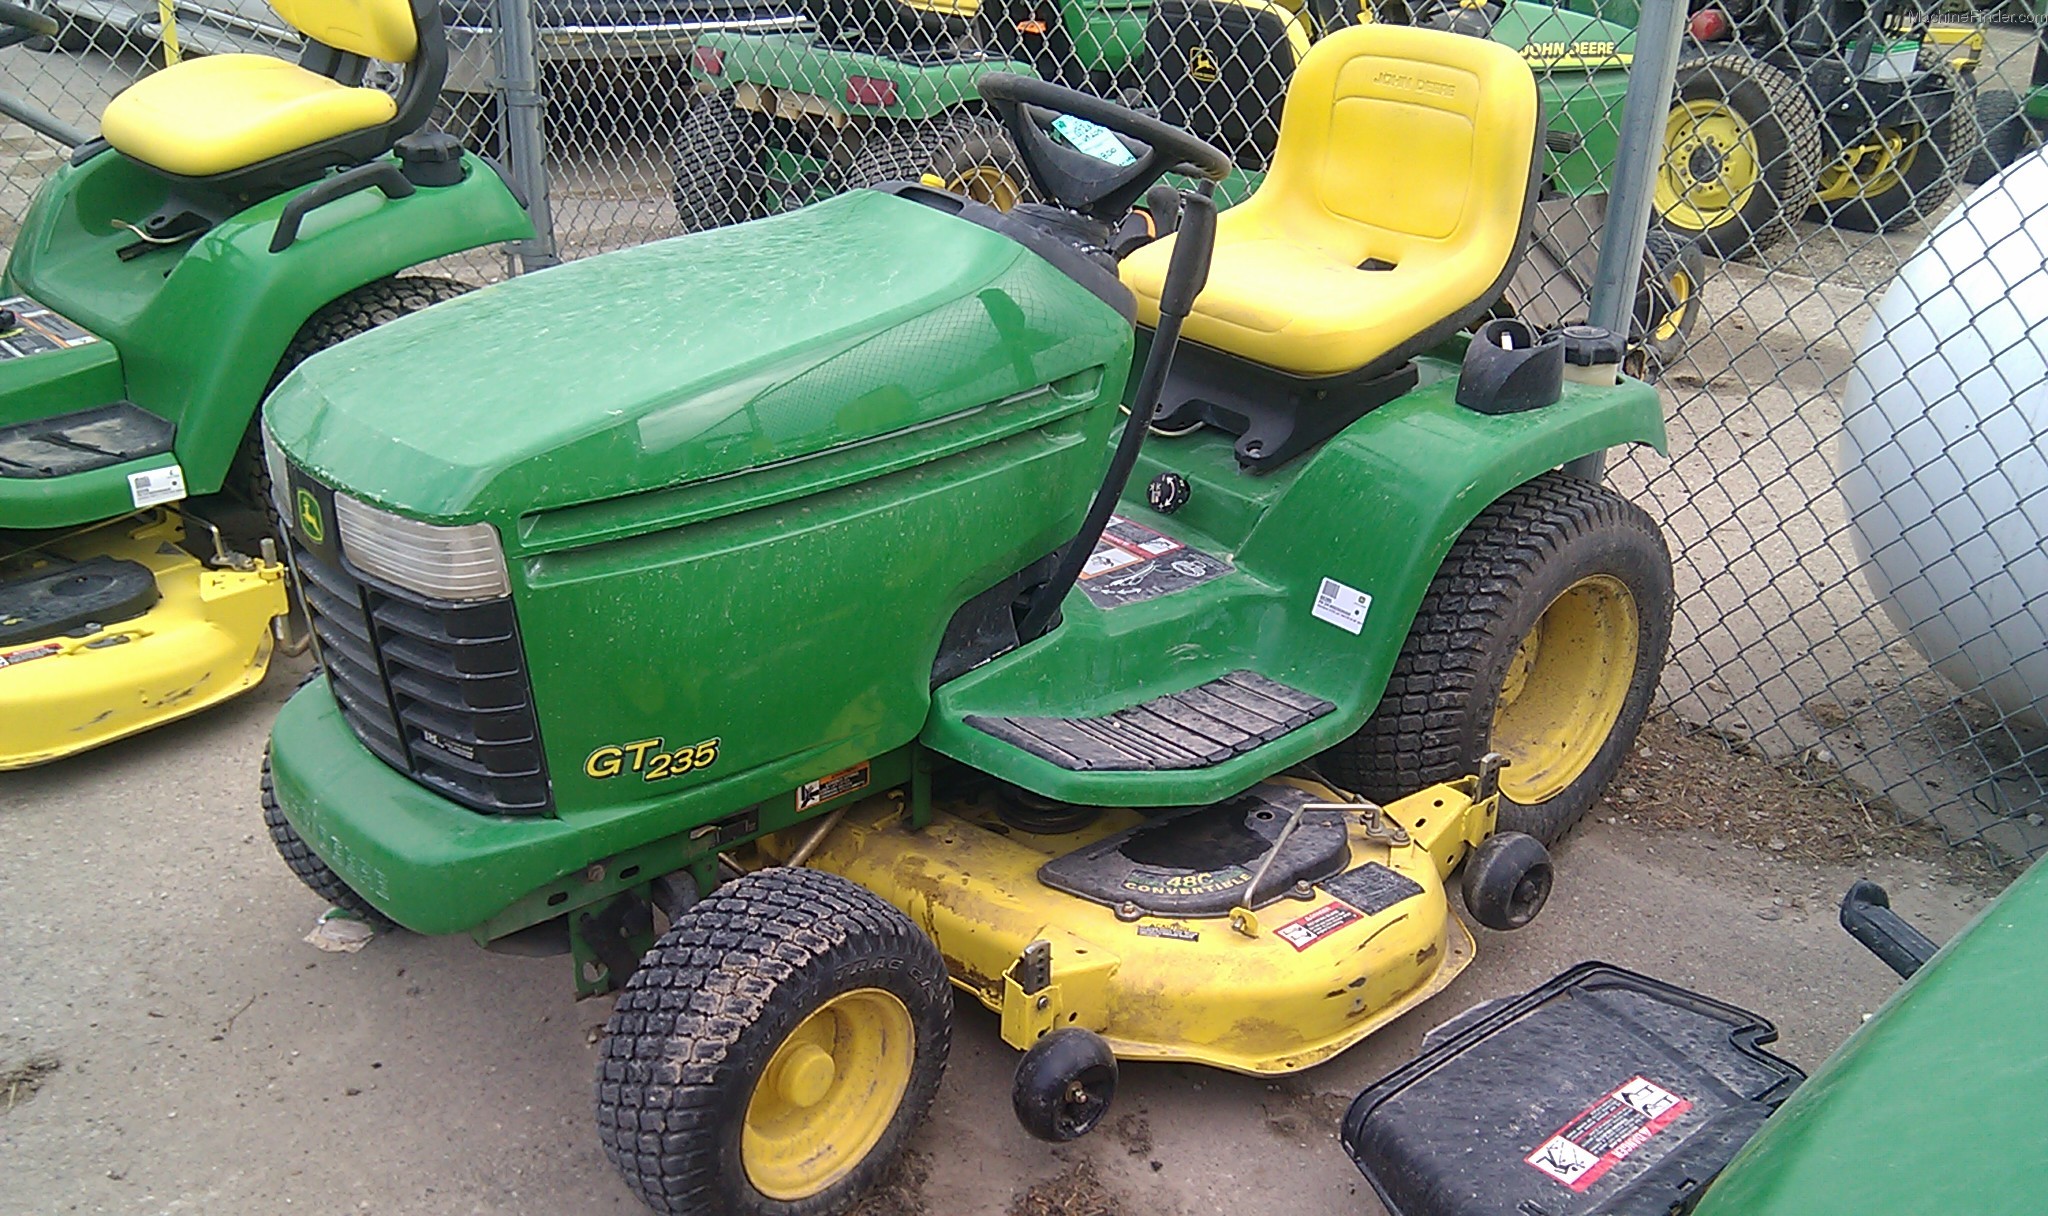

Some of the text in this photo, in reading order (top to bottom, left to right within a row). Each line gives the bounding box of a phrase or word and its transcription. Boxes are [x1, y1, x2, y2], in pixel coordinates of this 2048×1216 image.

[1521, 41, 1616, 59] JOHN DEERE
[1374, 72, 1456, 97] JOHN DEERE
[1123, 872, 1254, 896] CONVERTIBLE
[1164, 871, 1215, 889] 48C
